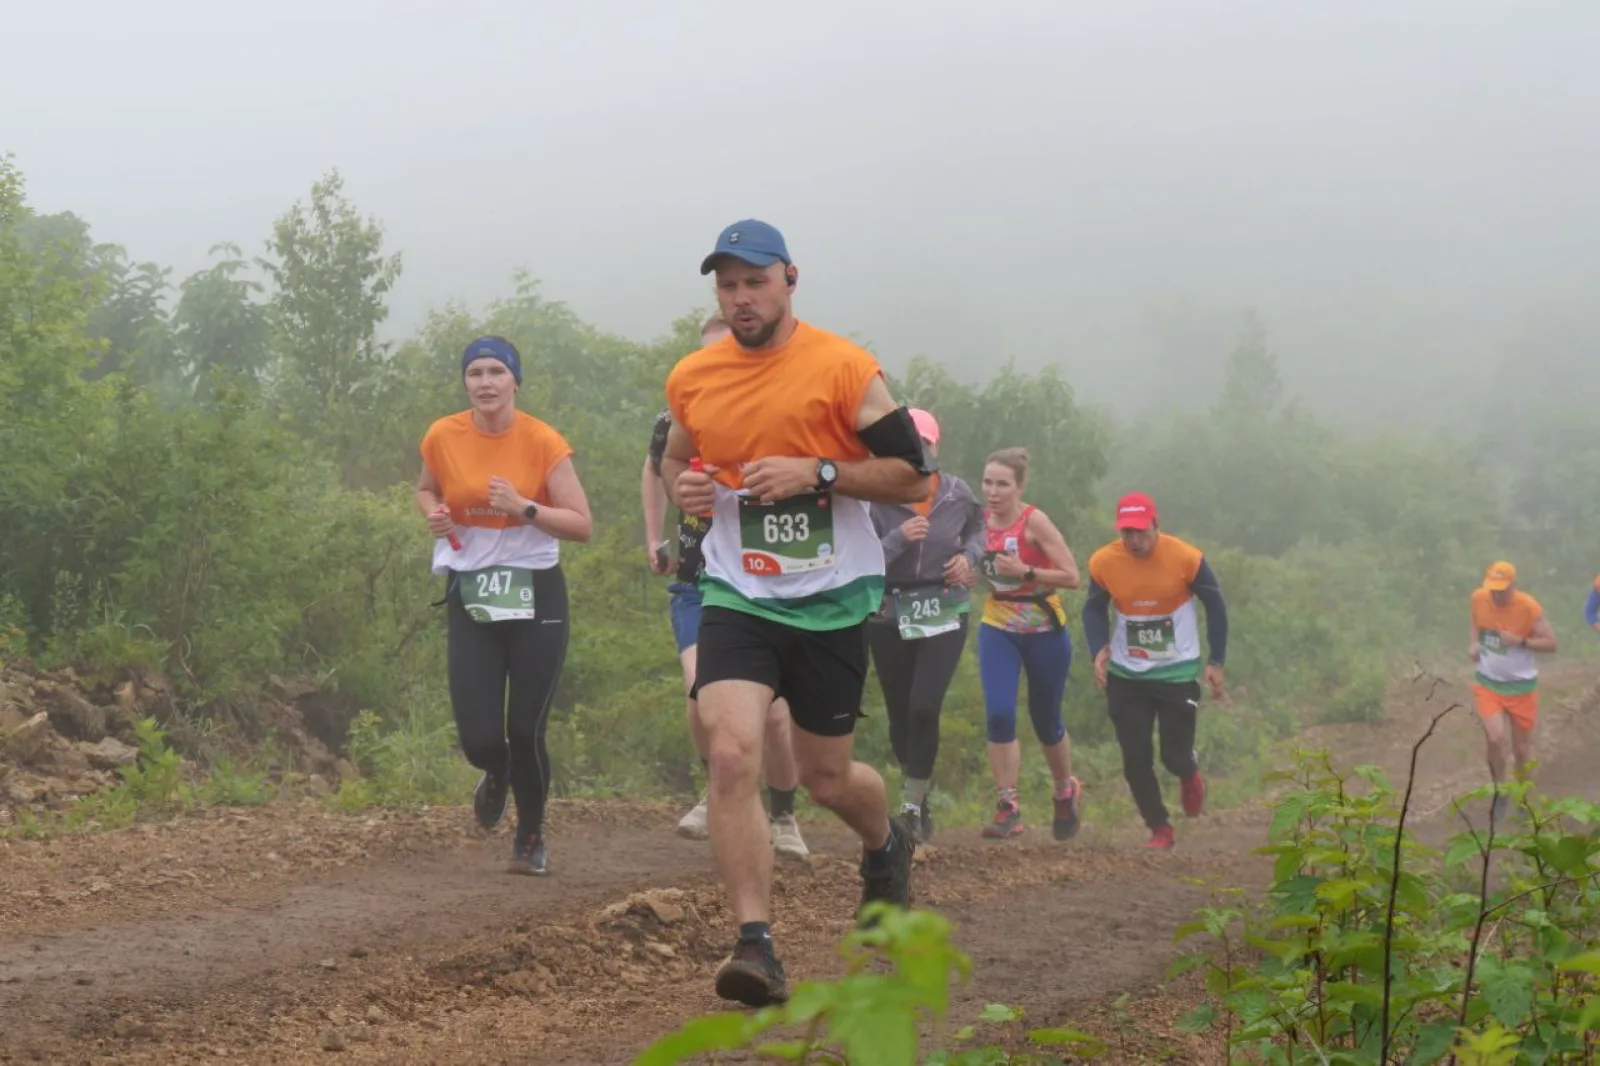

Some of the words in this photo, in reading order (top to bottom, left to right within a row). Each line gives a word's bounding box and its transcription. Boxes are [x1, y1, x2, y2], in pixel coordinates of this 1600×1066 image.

[763, 512, 810, 544] 633
[748, 557, 766, 571] 10
[476, 570, 512, 597] 247
[911, 597, 941, 620] 243
[1138, 628, 1163, 645] 634
